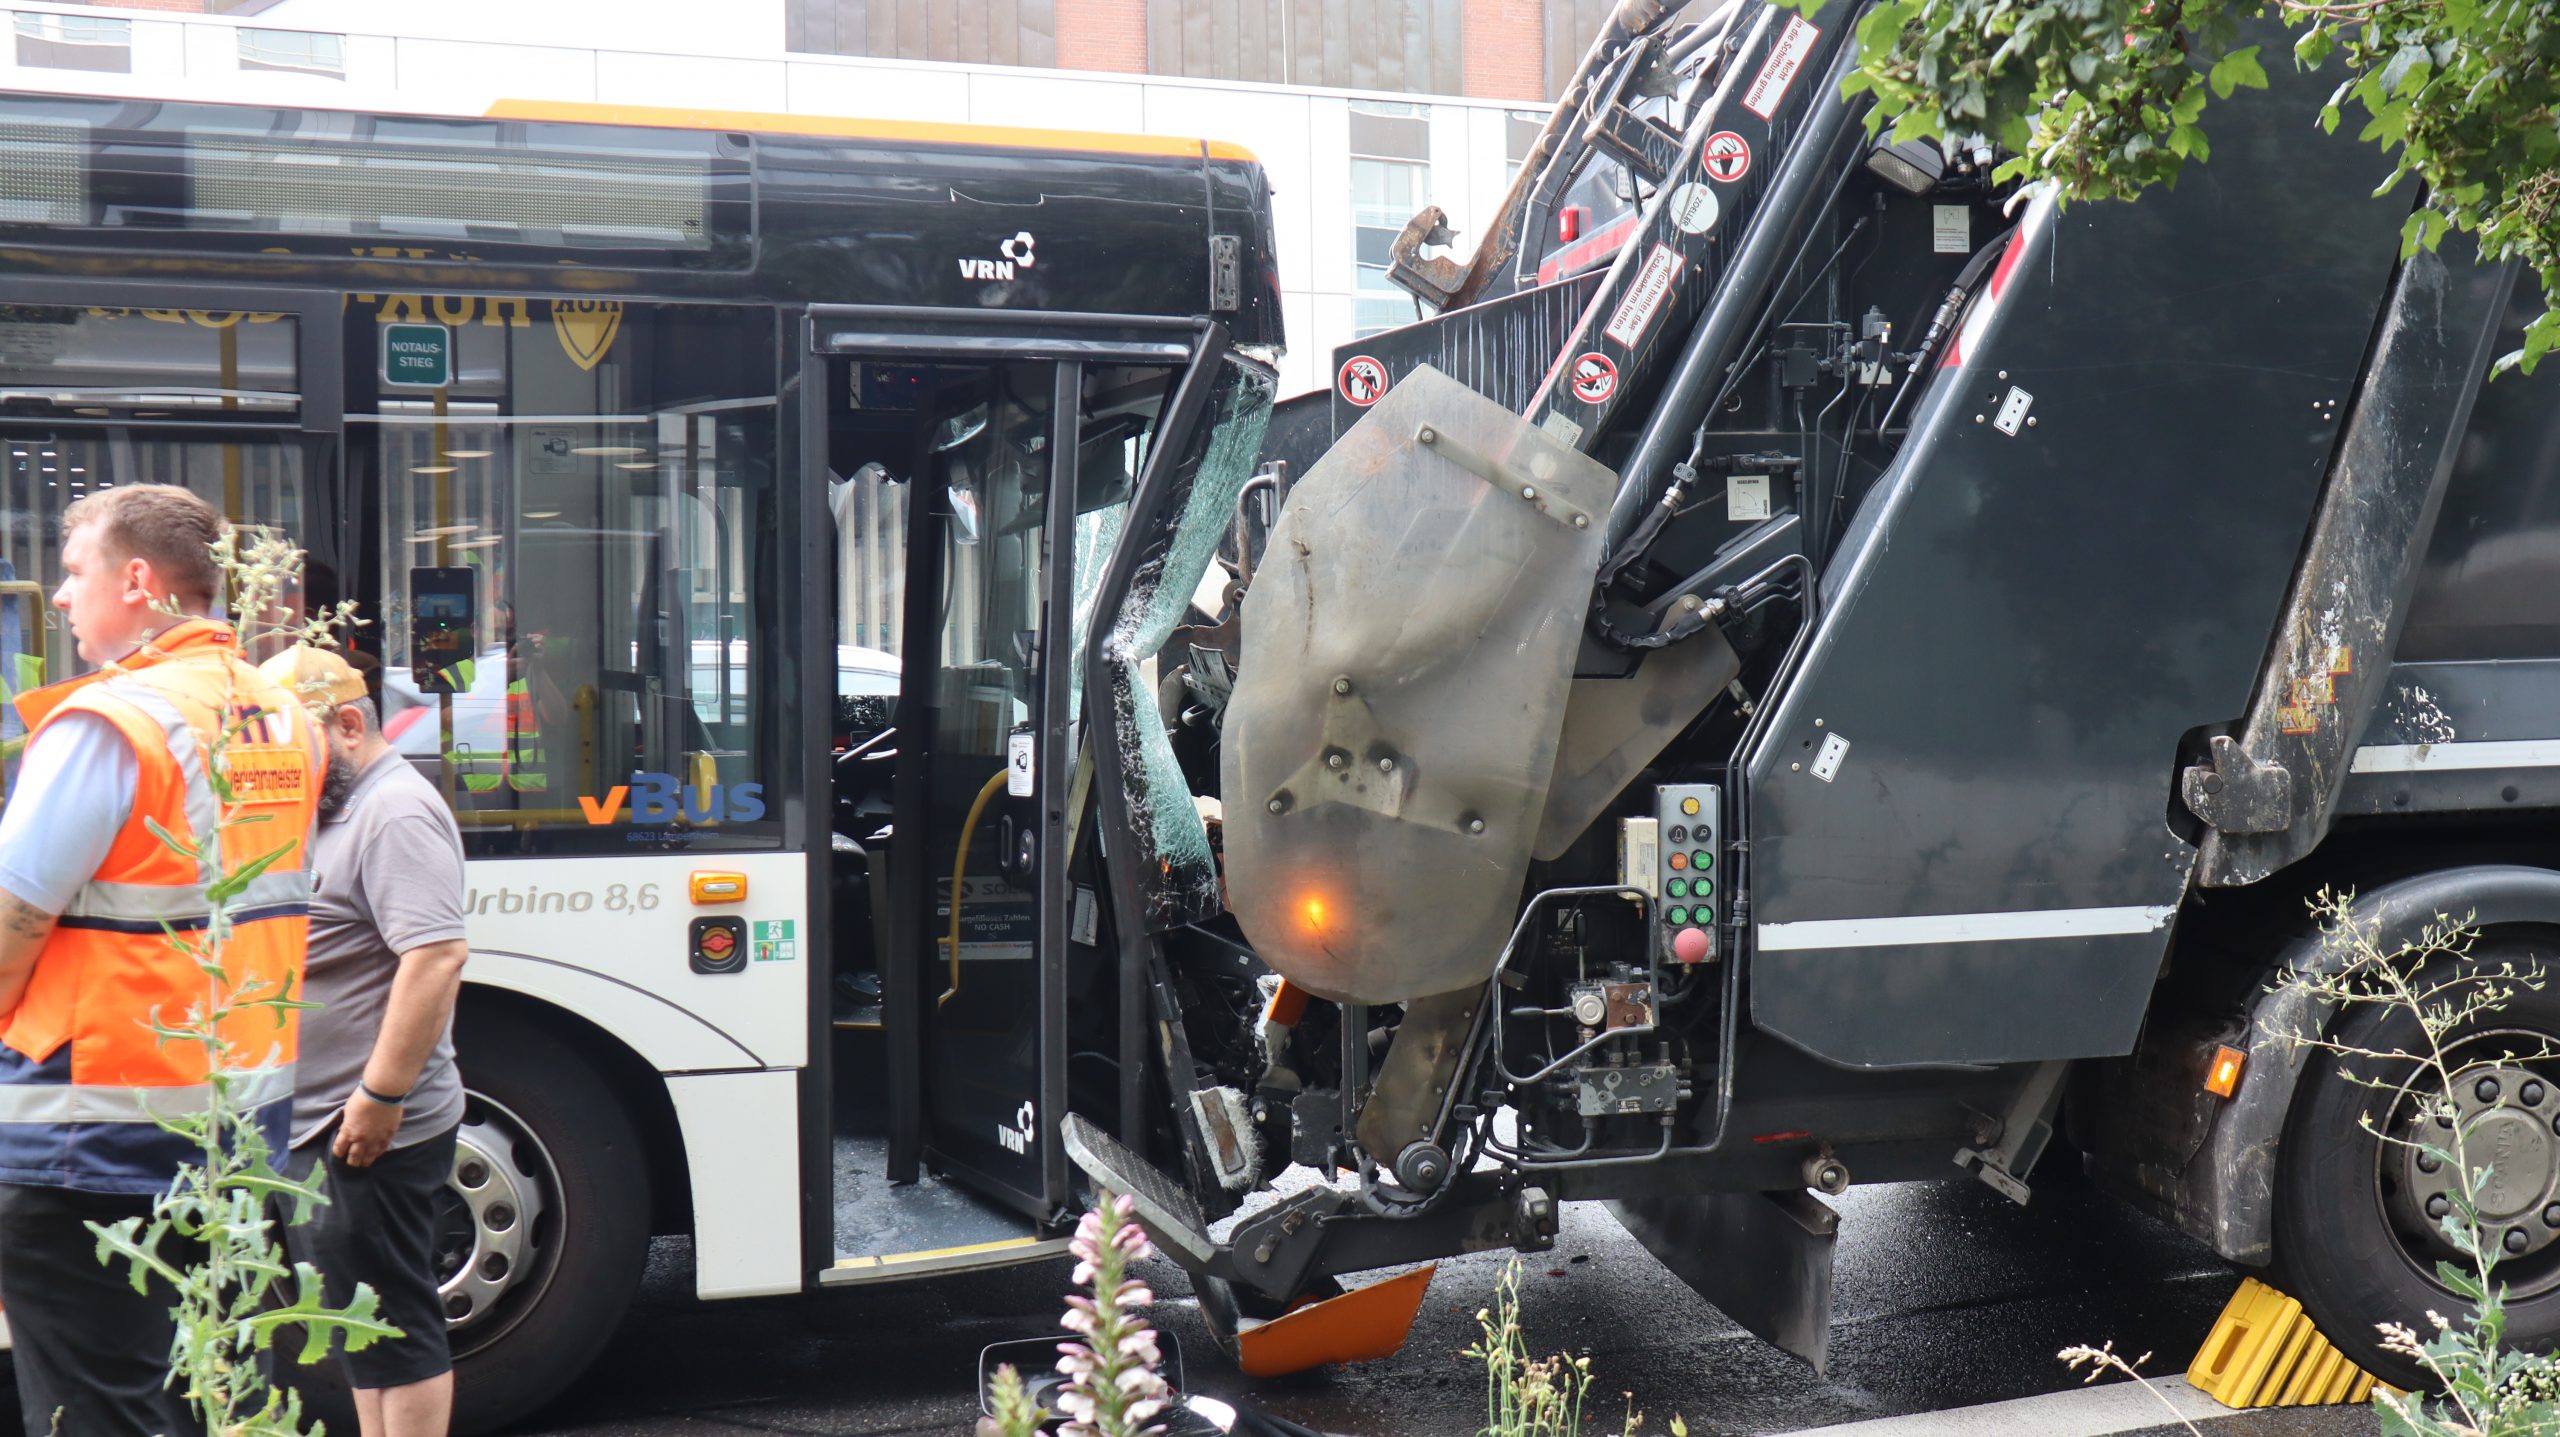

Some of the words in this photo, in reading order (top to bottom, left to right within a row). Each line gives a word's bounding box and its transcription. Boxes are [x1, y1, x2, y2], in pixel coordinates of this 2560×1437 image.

[1797, 19, 1806, 29] in
[1787, 30, 1802, 42] die
[1778, 59, 1796, 81] Nicht
[1749, 79, 1769, 107] greifen
[1683, 196, 1703, 226] ZOELLER
[958, 258, 1015, 280] VRN
[1638, 289, 1658, 314] hinter
[1614, 306, 1634, 330] treten
[391, 341, 443, 353] NOTAUS-
[399, 356, 434, 368] STIEG
[577, 772, 766, 825] vBus
[626, 832, 655, 842] 68623
[602, 882, 660, 915] 8,6
[989, 923, 1011, 931] CASH
[998, 1123, 1024, 1155] VRN
